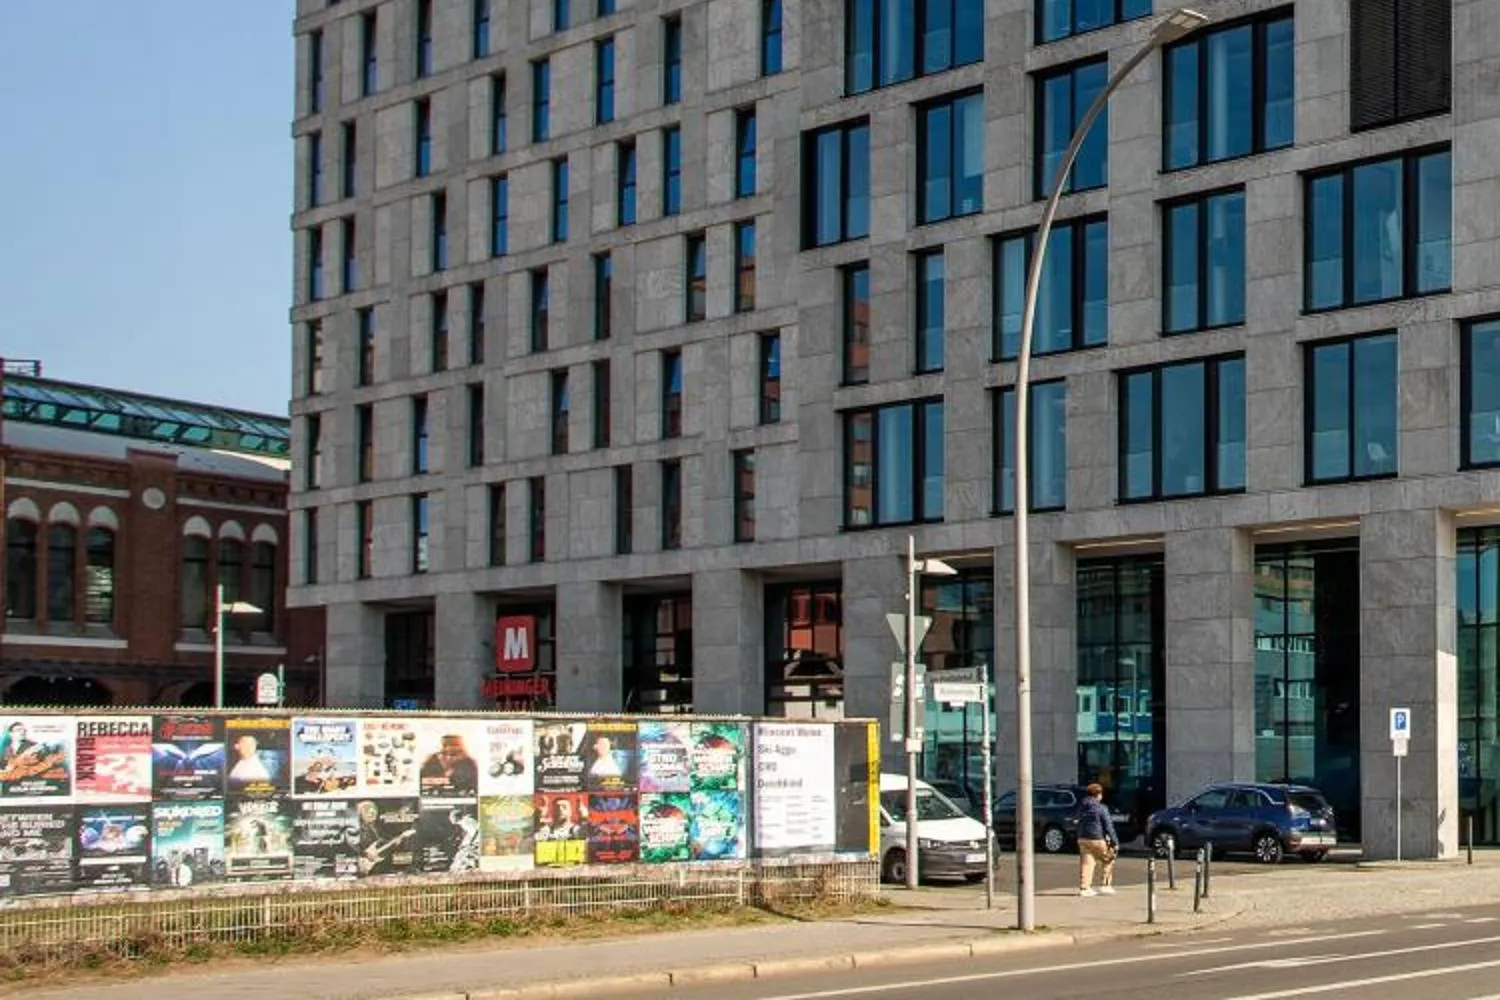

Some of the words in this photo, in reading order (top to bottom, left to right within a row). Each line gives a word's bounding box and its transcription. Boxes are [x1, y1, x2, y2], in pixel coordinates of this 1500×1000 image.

[503, 627, 529, 661] M
[481, 678, 551, 697] MEININGER
[77, 720, 151, 738] REBECCA
[76, 737, 96, 781] BLACK
